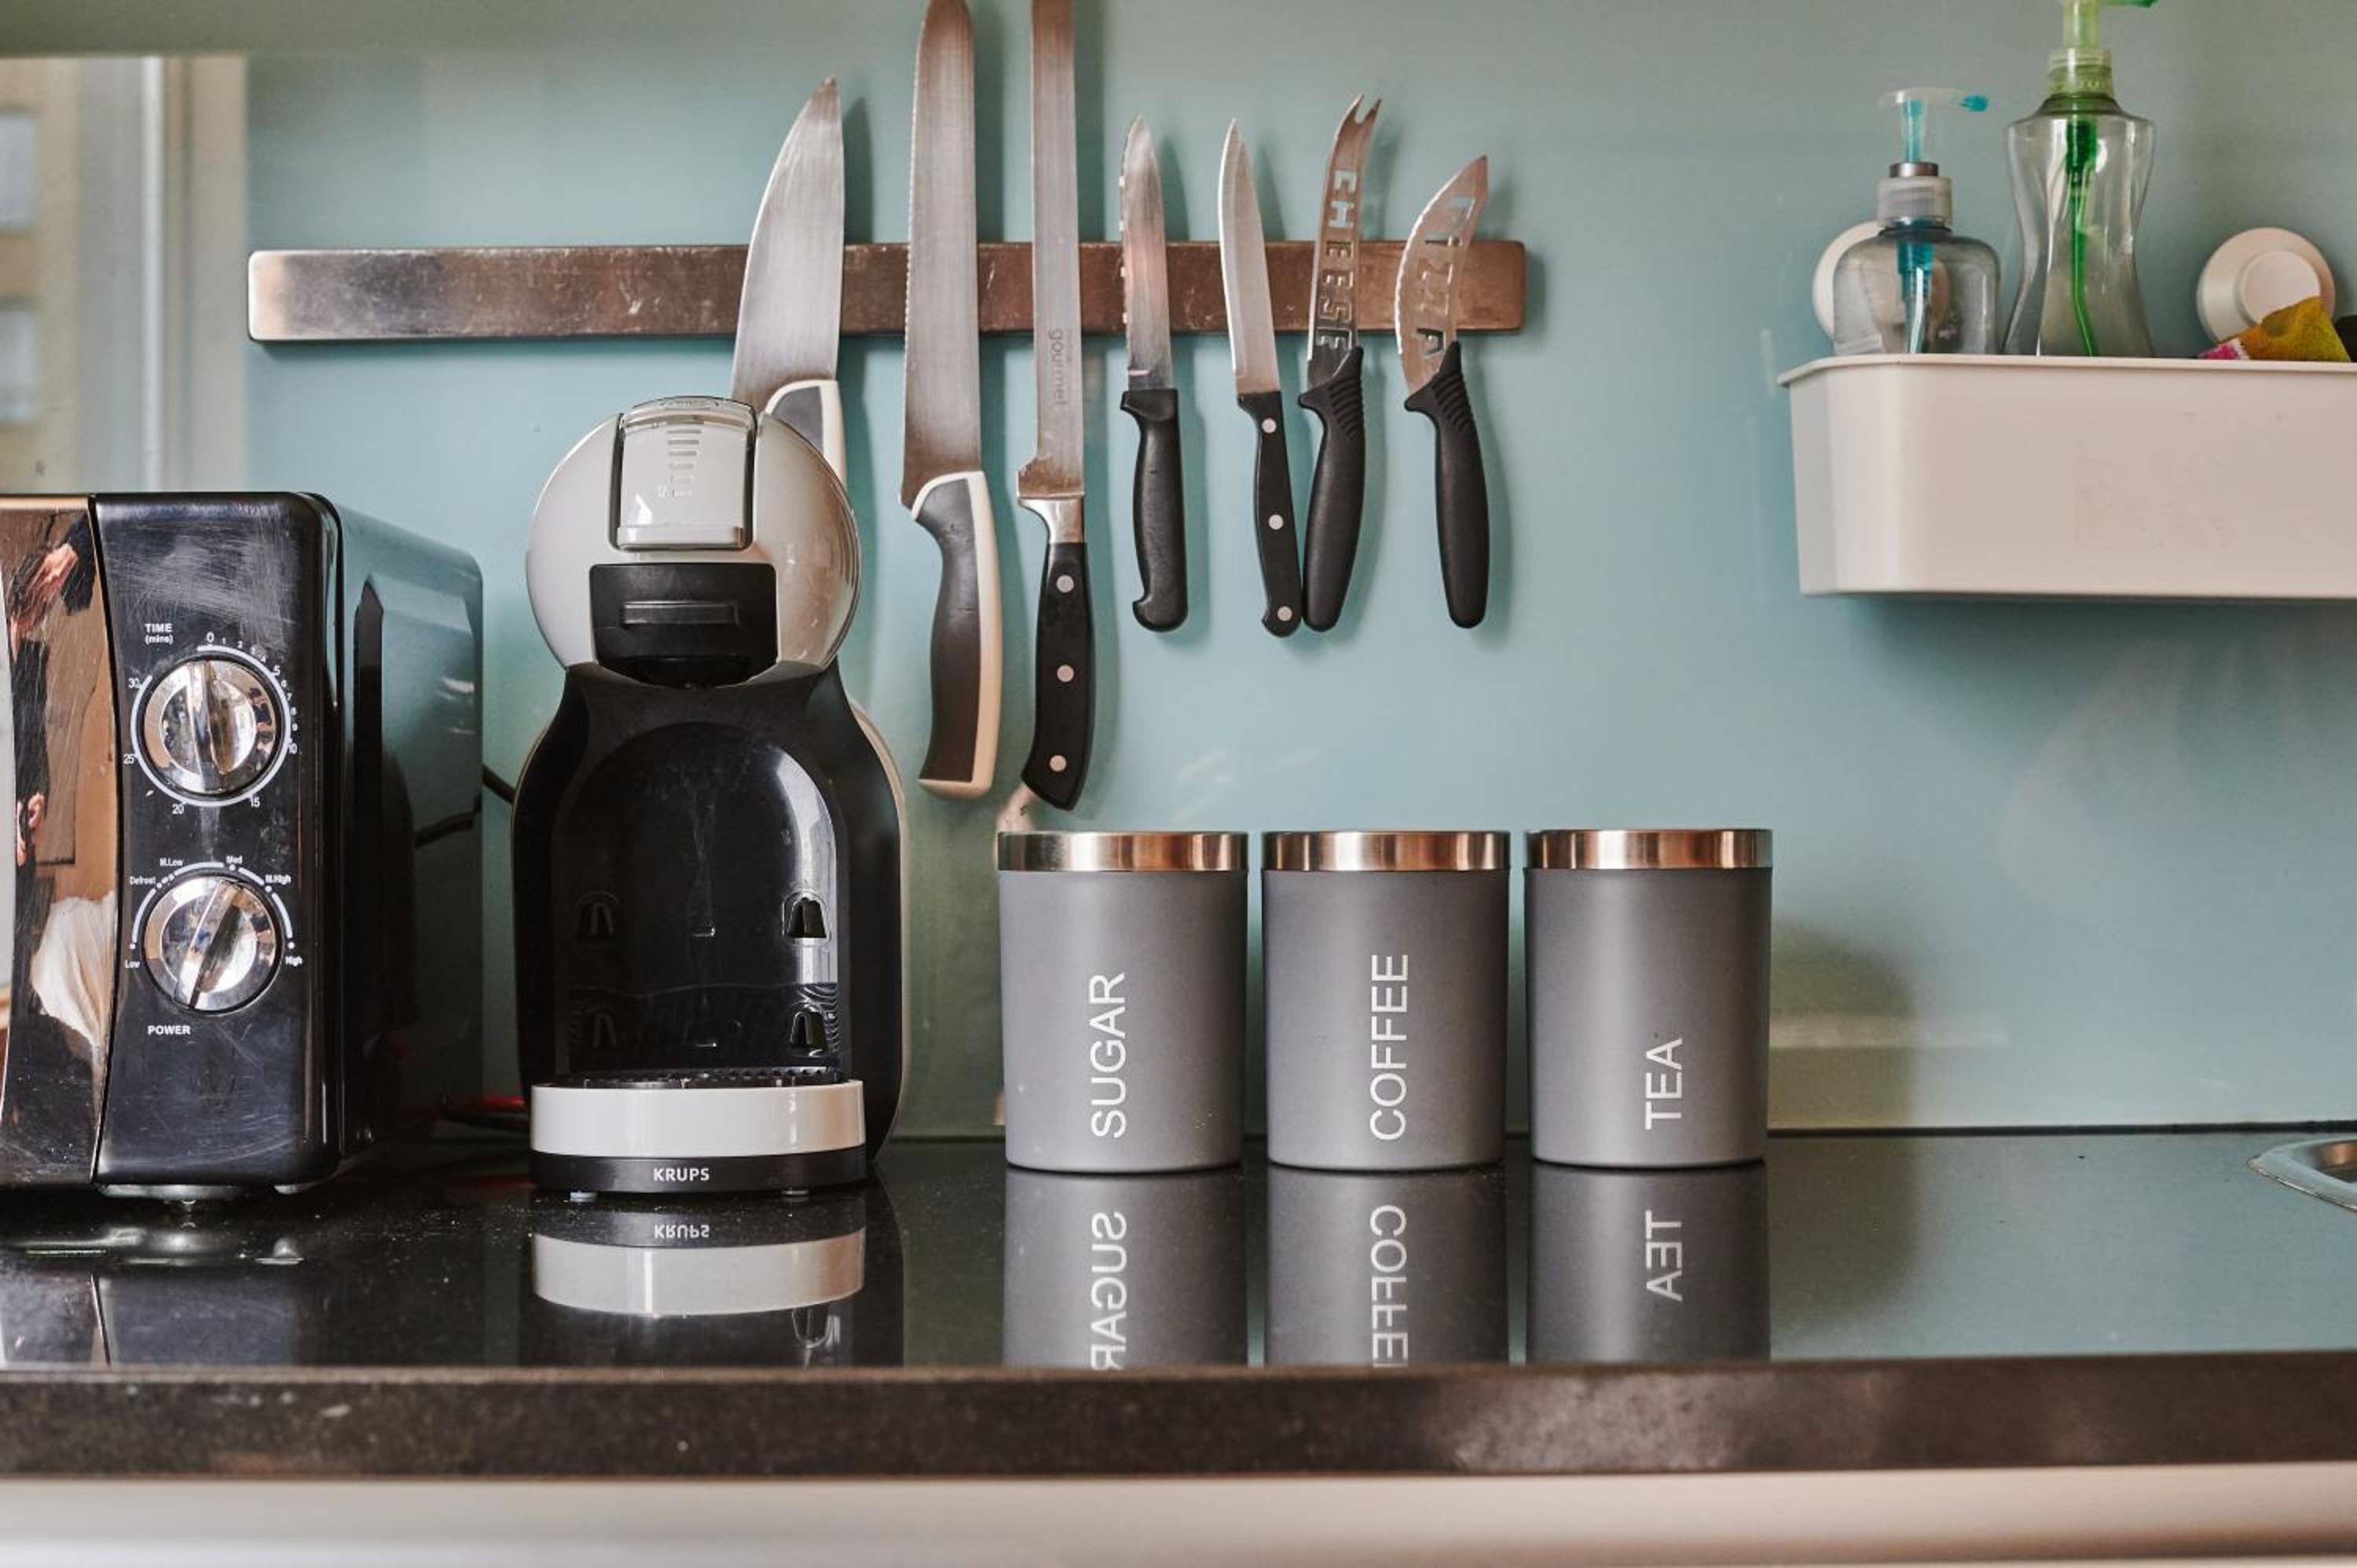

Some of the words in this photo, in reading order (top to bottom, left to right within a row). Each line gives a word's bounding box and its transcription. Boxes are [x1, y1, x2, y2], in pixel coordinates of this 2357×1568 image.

[1315, 170, 1358, 350] CHEESE
[145, 623, 174, 633] TIME
[145, 634, 174, 645] (mins)
[207, 632, 214, 643] 0
[273, 665, 280, 676] 5
[123, 753, 134, 765] 25
[250, 796, 260, 808] 15
[172, 804, 185, 815] 20
[160, 858, 184, 867] M.Low
[226, 855, 243, 865] Med
[130, 876, 156, 886] Defrost
[125, 959, 141, 969] Low
[285, 956, 302, 967] High
[147, 1024, 191, 1035] POWER
[1370, 954, 1409, 1141] COFFEE
[1090, 972, 1127, 1138] SUGAR
[1645, 1038, 1683, 1130] TEA
[653, 1167, 710, 1181] KRUPS
